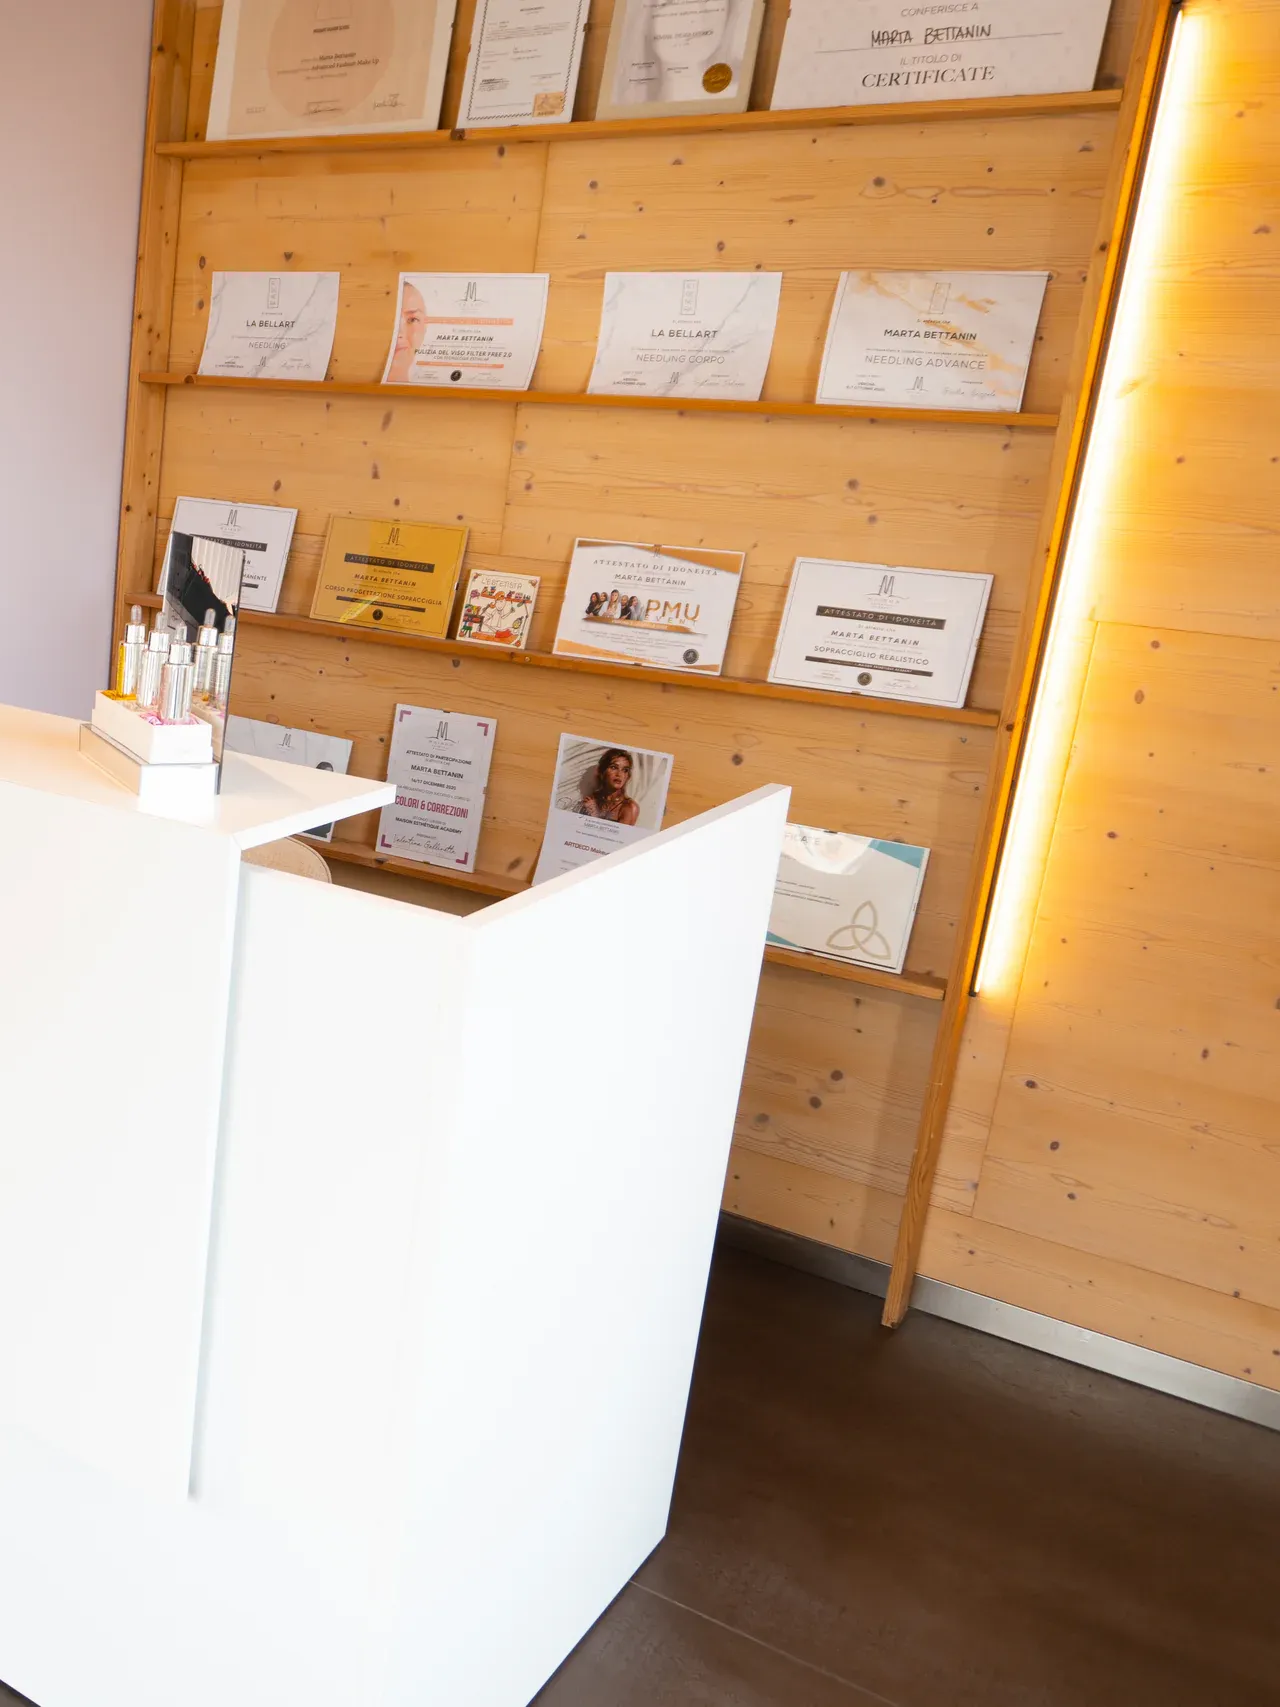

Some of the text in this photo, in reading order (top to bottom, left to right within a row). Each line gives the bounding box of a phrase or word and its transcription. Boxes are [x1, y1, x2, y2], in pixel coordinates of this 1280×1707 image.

[901, 3, 980, 18] CONFERISCE A
[871, 24, 992, 47] MARTA BETTANIN
[900, 53, 962, 66] IL TITOLO DI
[861, 65, 996, 89] CERTIFICATE
[246, 320, 296, 329] LA BELLART
[436, 334, 495, 343] MARTA BETTANIN
[651, 328, 719, 339] LA BELLART
[883, 328, 977, 341] MARTA BETTANIN
[248, 341, 287, 350] NEEDLING
[414, 348, 438, 356] PULIZIA
[466, 350, 487, 358] FILTER
[636, 353, 726, 365] NEEDLING CORPO
[864, 355, 986, 371] NEEDLING ADVANCE
[349, 555, 386, 566] ATTESTATO
[592, 558, 649, 571] ATTESTATO
[652, 563, 664, 572] DI
[353, 572, 417, 587] MARTA BETTANIN
[614, 573, 687, 587] MARTA BETTANIN
[324, 584, 346, 593] CORSO
[346, 587, 396, 600] PROGETTAZIONE
[397, 594, 443, 606] SOPRACCIGLIA
[645, 598, 701, 621] PMU
[823, 608, 875, 620] ATTESTATO
[878, 614, 891, 622] DI
[644, 615, 697, 627] EVENT
[830, 629, 920, 646] MARTA BETTANIN
[814, 645, 877, 659] SOPRACCIGLIO
[879, 653, 930, 666] REALISTICO
[405, 749, 430, 758] ATTESTATO
[435, 754, 472, 766] PARTECIPAZIONE
[410, 763, 464, 779] MARTA BETTANIN
[423, 780, 445, 788] DICEMBRE
[395, 795, 469, 819] COLORI & CORREZIONI
[395, 816, 413, 825] MAISON
[440, 825, 462, 834] ACADEMY
[564, 840, 590, 851] ARTDECO
